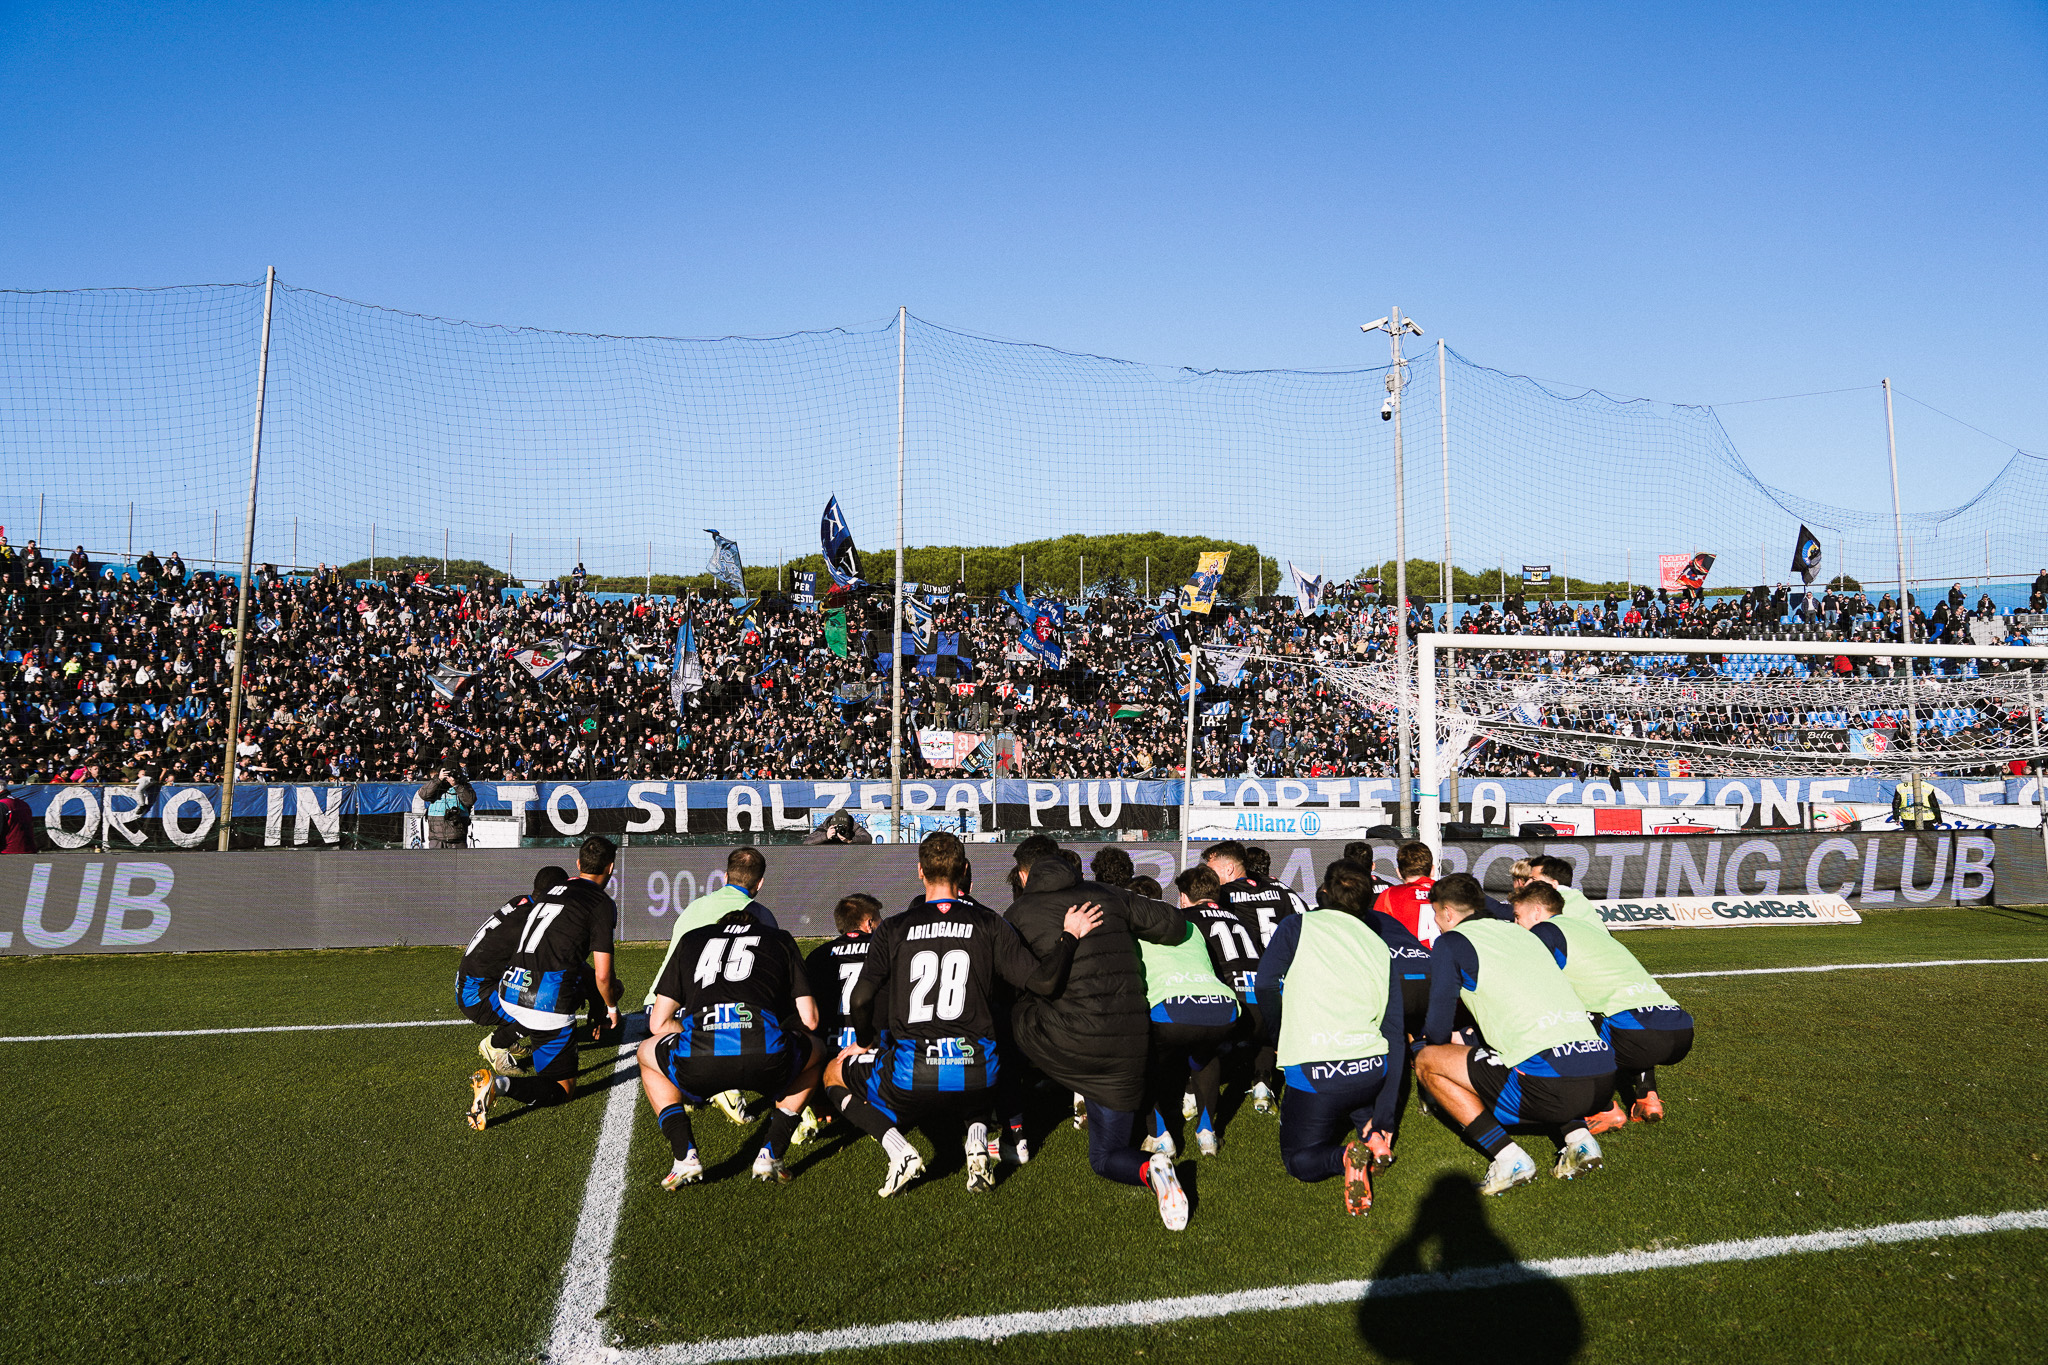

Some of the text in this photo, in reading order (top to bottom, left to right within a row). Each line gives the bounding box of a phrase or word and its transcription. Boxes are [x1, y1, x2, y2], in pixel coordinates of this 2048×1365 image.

[793, 570, 814, 582] VIVO
[794, 581, 810, 592] PER
[263, 786, 344, 847] IN
[625, 782, 689, 833] SI
[1235, 813, 1296, 833] Allianz
[1805, 836, 1996, 905] CLUB
[1595, 903, 1676, 922] oldBet
[516, 902, 565, 954] 17
[906, 921, 974, 941] ABILDGAARD
[1256, 907, 1279, 949] 5
[1209, 920, 1260, 962] 11
[694, 935, 762, 990] 45
[838, 961, 865, 1016] 7
[907, 949, 971, 1024] 28
[702, 1002, 753, 1025] HTS
[702, 1021, 753, 1032] VERDE SPORTIVO
[925, 1037, 975, 1058] HTS
[925, 1057, 945, 1066] VERDE
